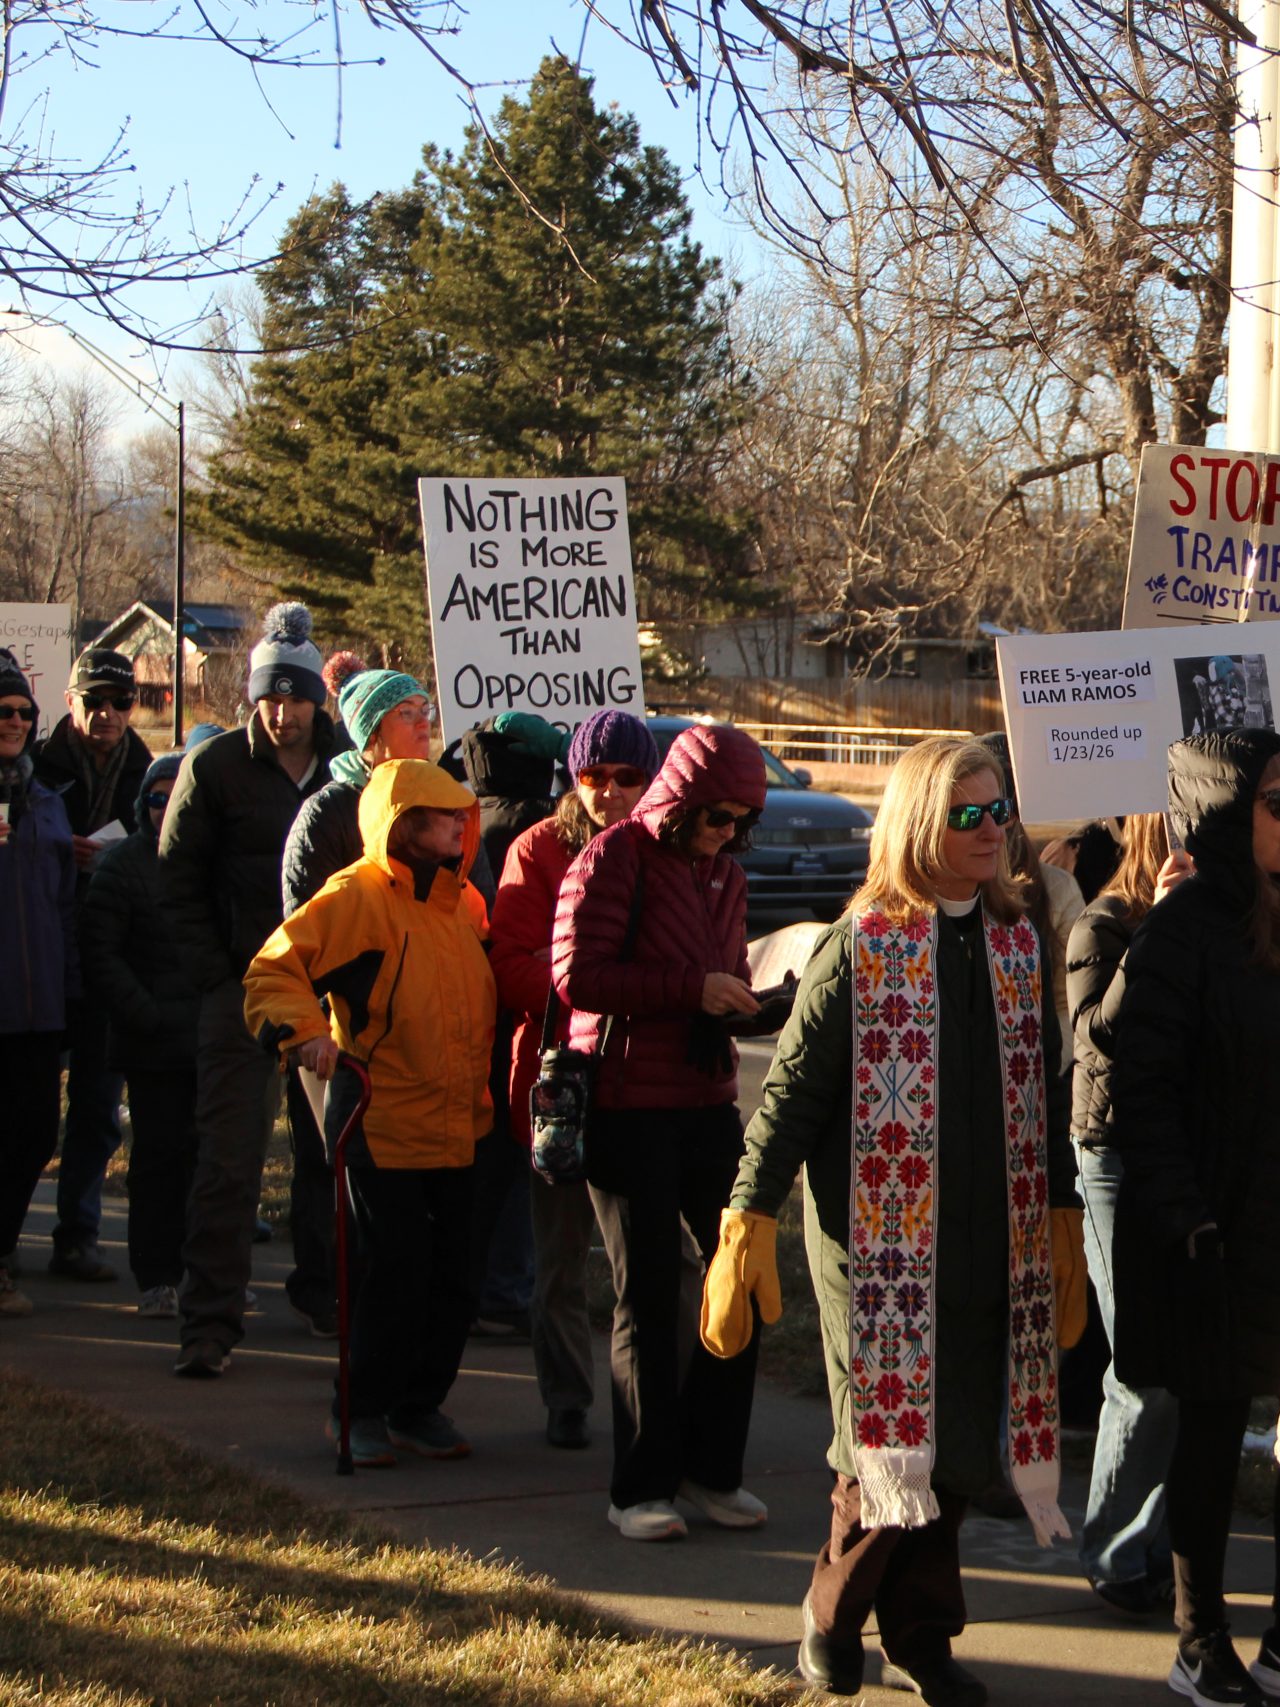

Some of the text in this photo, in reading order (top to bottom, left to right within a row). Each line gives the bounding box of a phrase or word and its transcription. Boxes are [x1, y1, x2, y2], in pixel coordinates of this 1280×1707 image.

[443, 483, 618, 532] NOTHING
[470, 536, 607, 568] IS MORE
[1144, 573, 1169, 593] THE
[440, 573, 627, 622] AMERICAN
[500, 626, 581, 655] THAN
[454, 663, 637, 708] OPPOSING
[1019, 661, 1152, 685] FREE 5-year-old
[1022, 683, 1137, 705] LIAM RAMOS
[1050, 726, 1142, 743] Rounded up
[1053, 744, 1115, 761] 1/23/26
